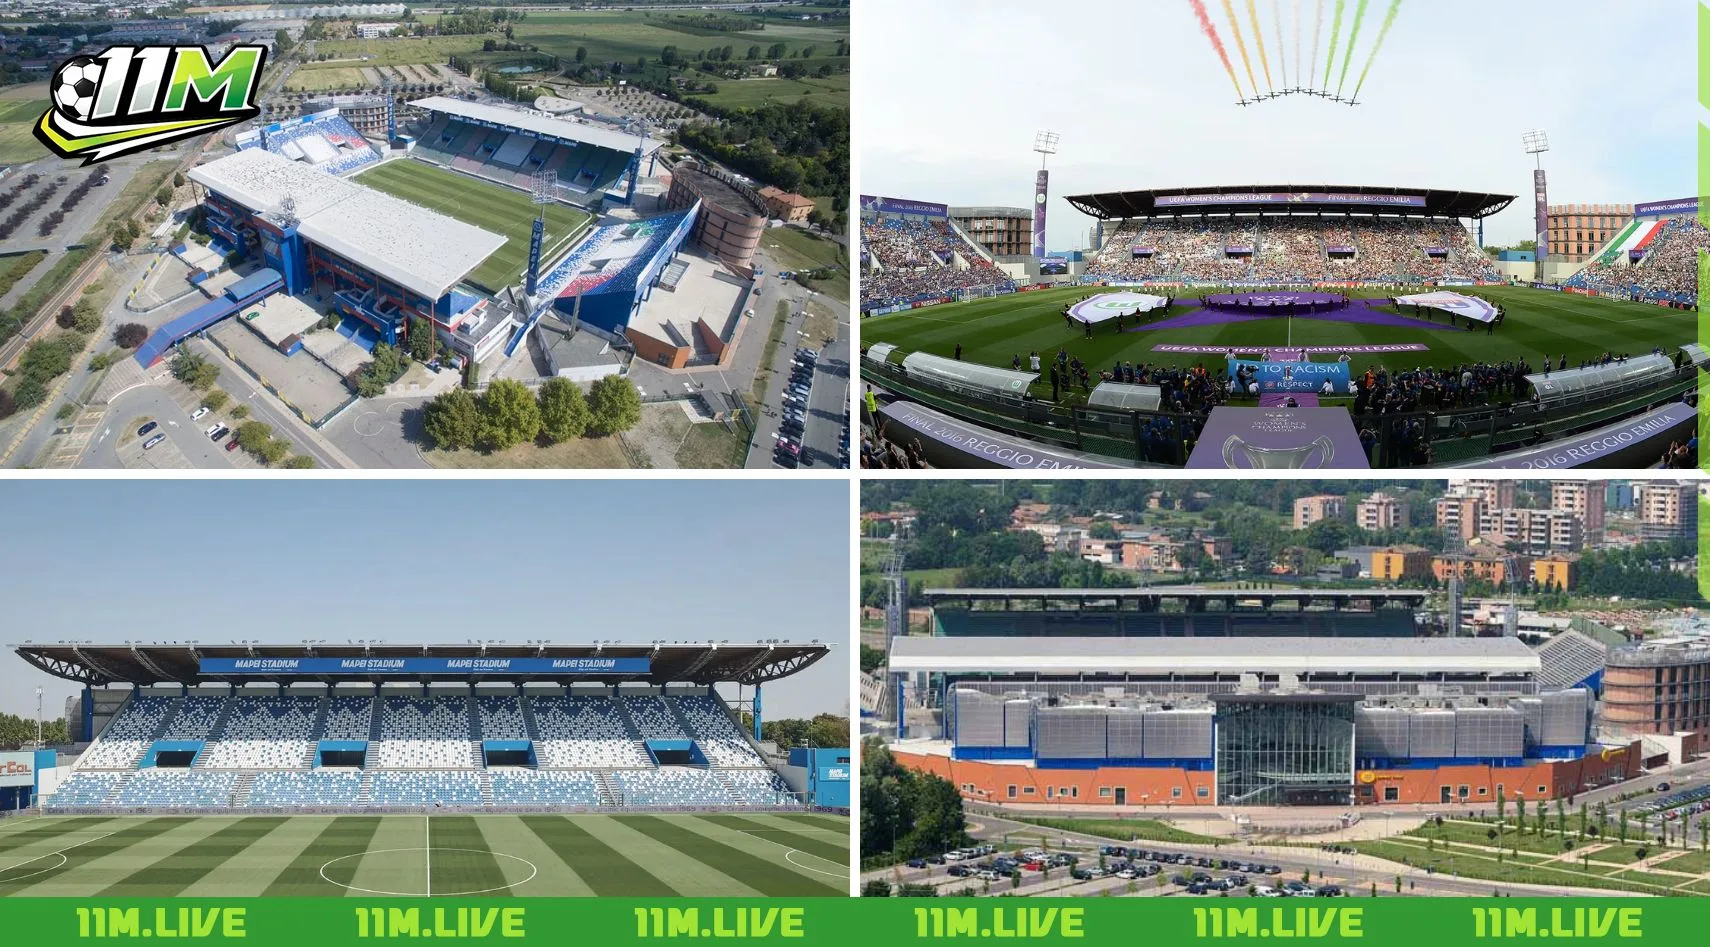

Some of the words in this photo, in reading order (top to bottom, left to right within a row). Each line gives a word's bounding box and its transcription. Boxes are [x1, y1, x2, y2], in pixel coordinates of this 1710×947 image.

[1262, 364, 1281, 373] TO
[1277, 381, 1313, 389] RESPECT
[902, 412, 932, 431] FINAL
[934, 427, 963, 443] 2016
[963, 437, 1034, 466] REGGIO
[1566, 432, 1633, 460] REGGIO
[1631, 415, 1676, 436] EMILIA
[235, 659, 260, 668] MAPEI
[261, 659, 299, 668] STADIUM
[341, 659, 367, 668] MAPEI
[367, 659, 405, 668] STADIUM
[447, 659, 472, 668] MAPEI
[473, 659, 511, 668] STADIUM
[552, 659, 577, 668] MAPEI
[578, 659, 616, 668] STADIUM
